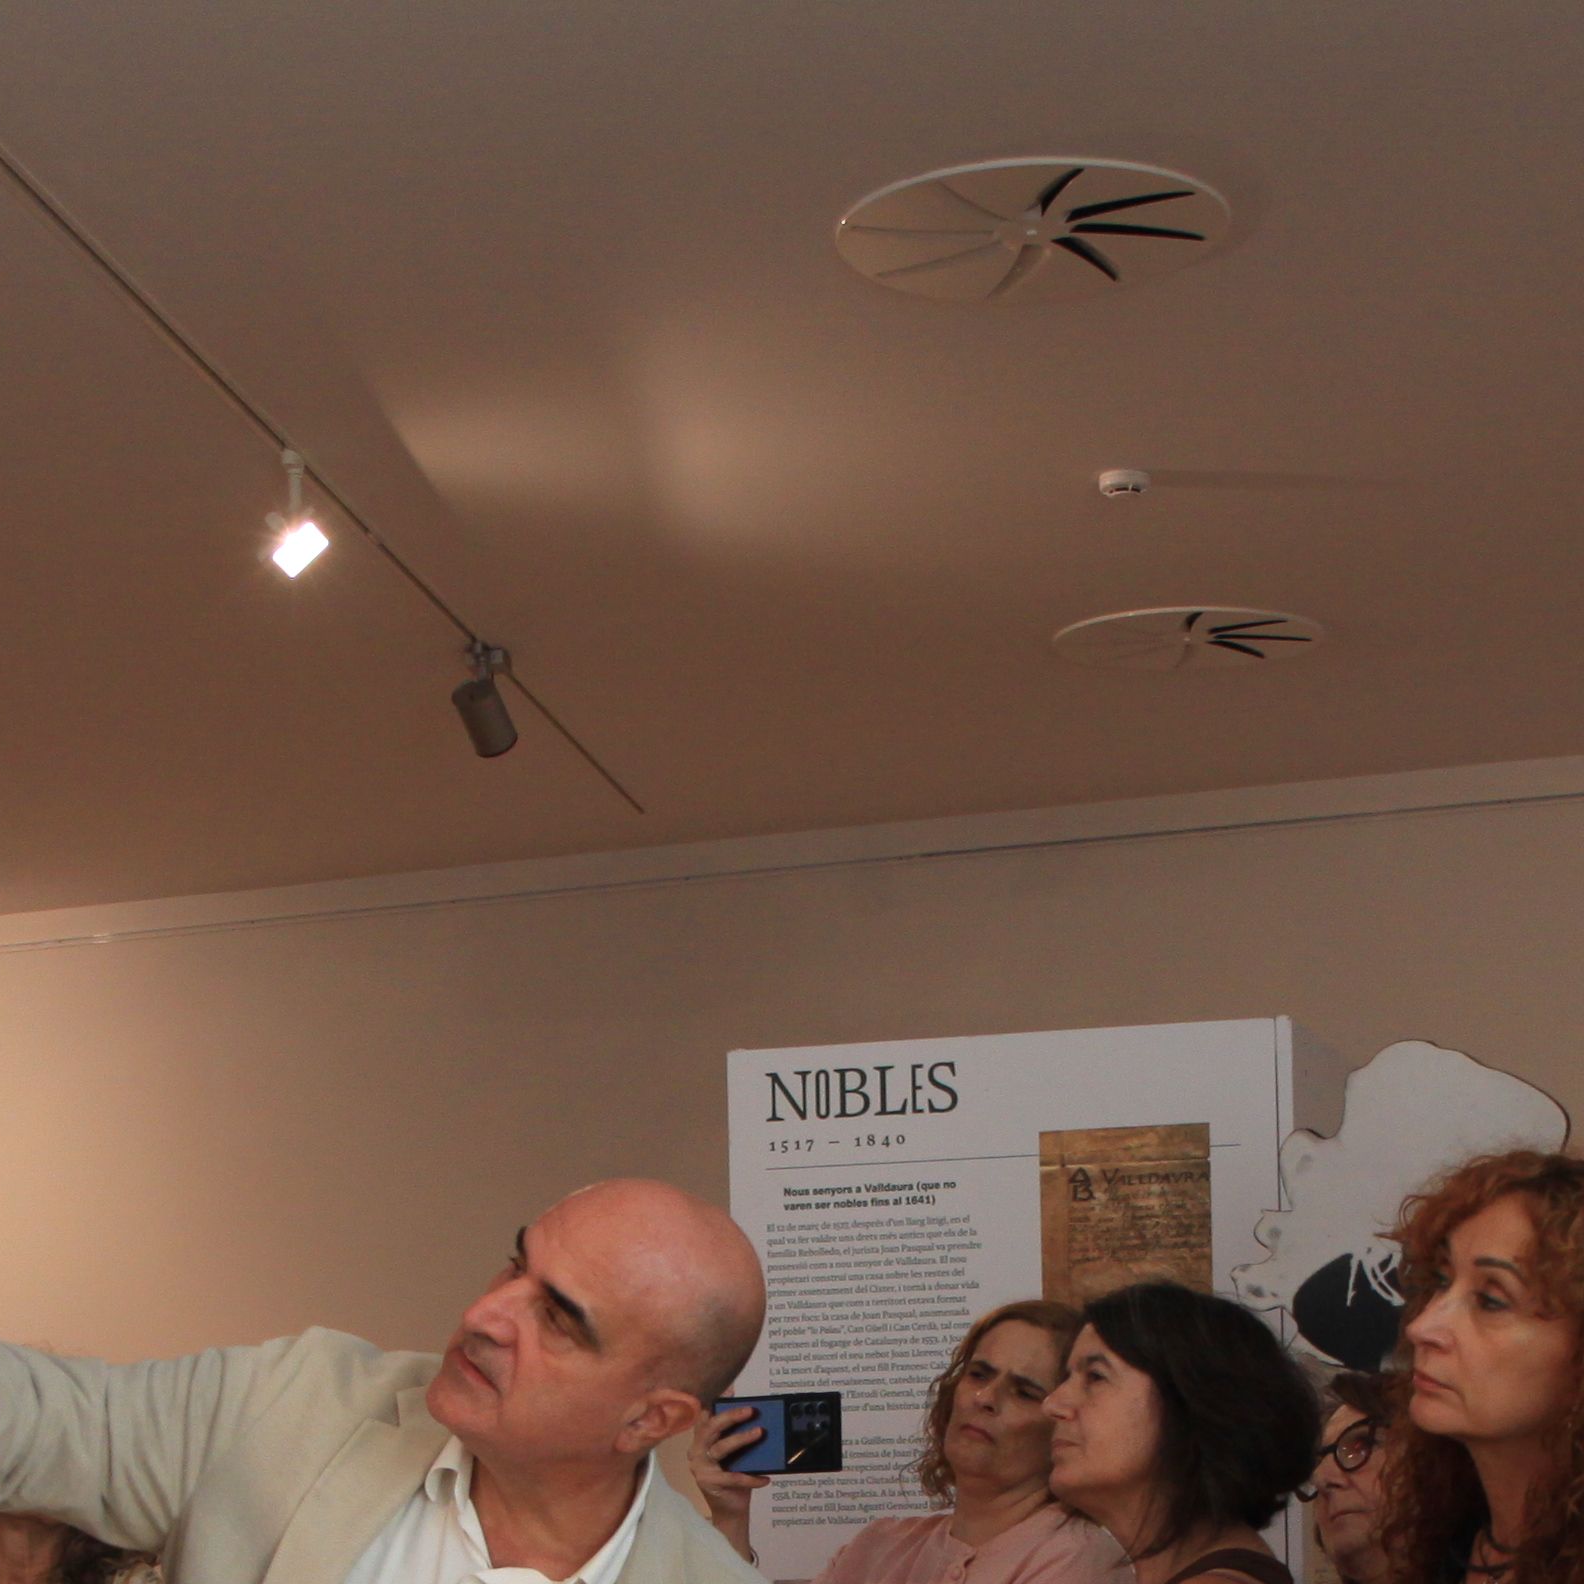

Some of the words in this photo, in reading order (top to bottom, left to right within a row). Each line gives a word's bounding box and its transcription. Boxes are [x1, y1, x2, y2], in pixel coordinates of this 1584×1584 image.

[765, 1061, 959, 1123] NOBLES
[768, 1138, 814, 1154] 1517
[855, 1133, 906, 1148] 1840
[783, 1186, 810, 1197] Nous
[812, 1184, 853, 1197] senyors
[854, 1184, 861, 1193] a
[864, 1182, 913, 1193] Valldaura
[916, 1180, 941, 1192] (que
[943, 1181, 956, 1190] no
[783, 1202, 812, 1211] varen
[814, 1200, 830, 1209] ser
[833, 1197, 868, 1208] nobles
[870, 1196, 890, 1207] fins
[892, 1196, 902, 1206] al
